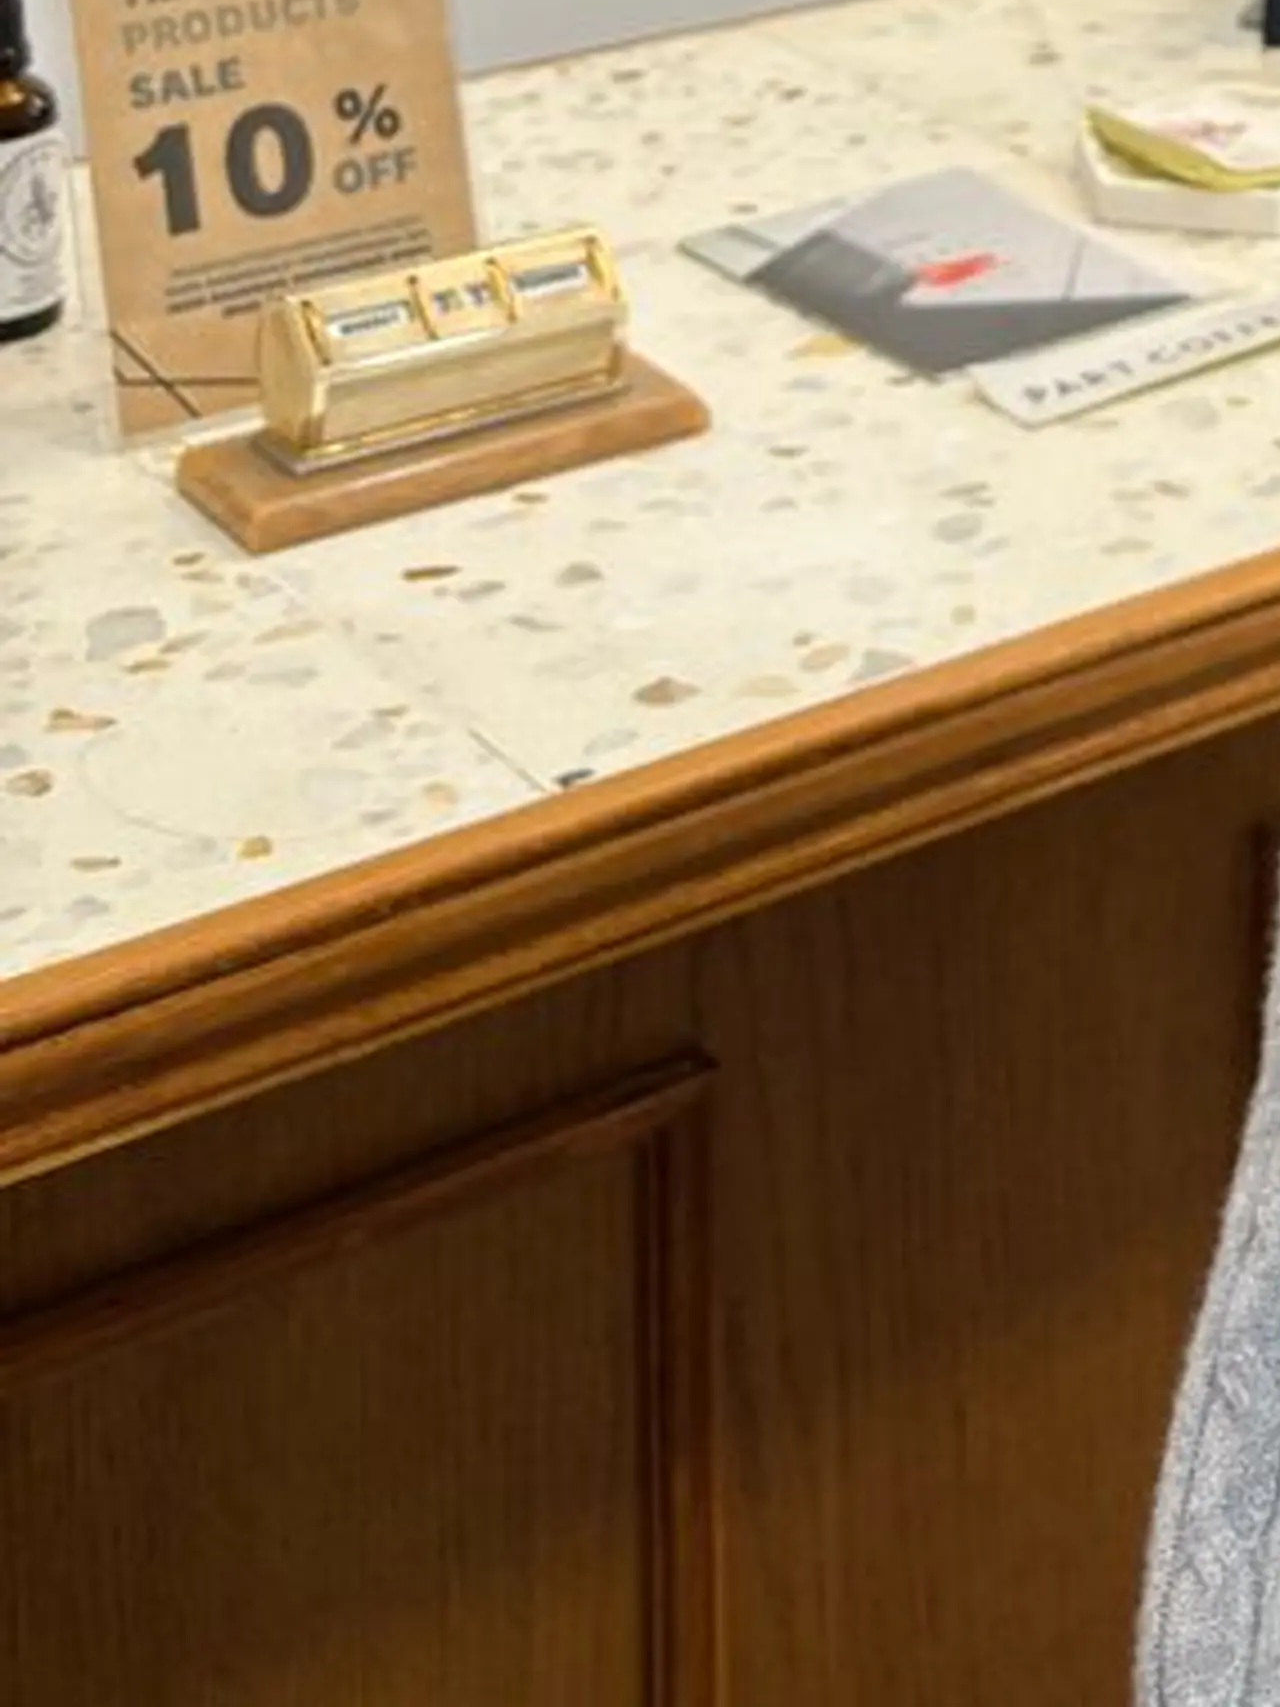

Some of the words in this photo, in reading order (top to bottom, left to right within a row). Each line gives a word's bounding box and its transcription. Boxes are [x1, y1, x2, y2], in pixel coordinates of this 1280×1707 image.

[129, 55, 247, 109] SALE
[134, 102, 314, 237] 10
[332, 146, 418, 195] OFF
